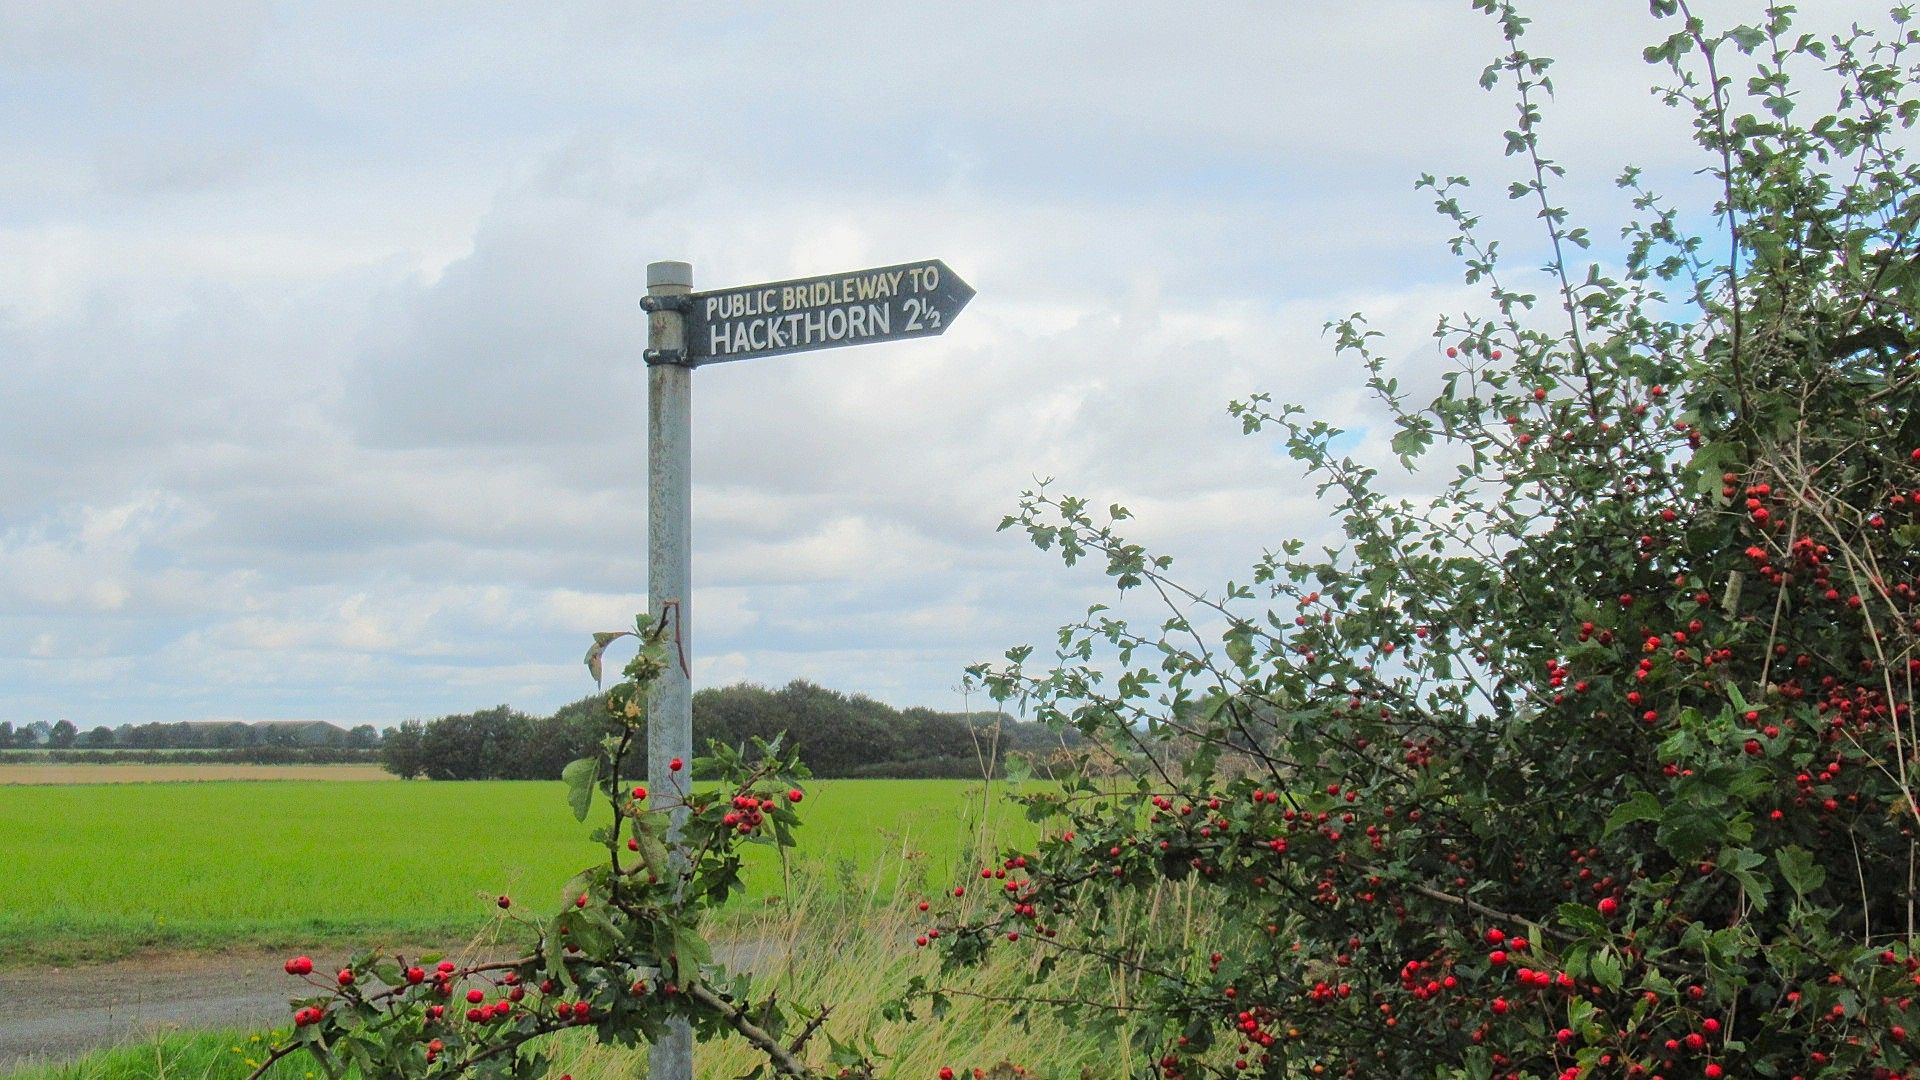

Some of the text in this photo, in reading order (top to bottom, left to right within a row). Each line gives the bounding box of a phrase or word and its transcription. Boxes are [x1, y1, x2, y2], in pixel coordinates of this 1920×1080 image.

[707, 266, 939, 321] PUBLIC BRIDLEWAY TO
[710, 302, 890, 355] HACKTHORN
